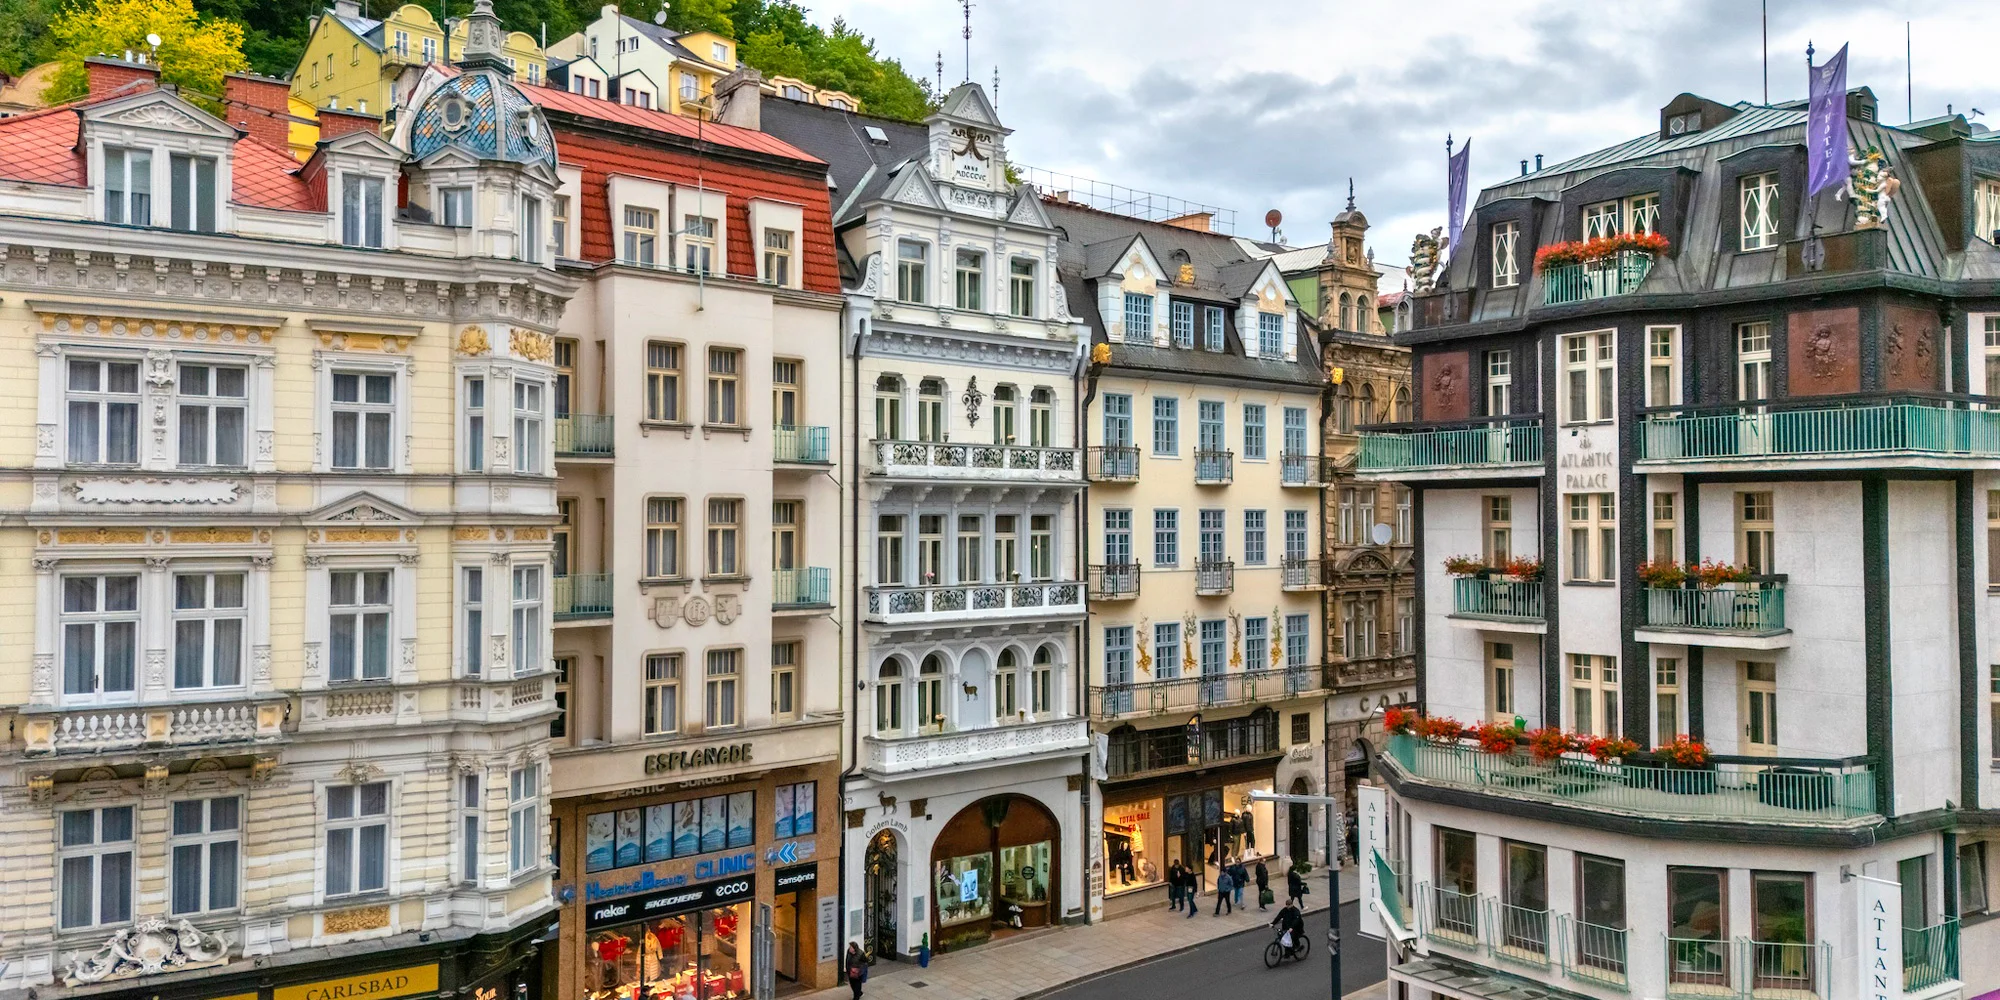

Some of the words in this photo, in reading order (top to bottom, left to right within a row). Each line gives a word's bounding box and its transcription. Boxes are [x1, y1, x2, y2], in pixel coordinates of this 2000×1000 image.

[1560, 452, 1613, 468] ATLANTIC
[1566, 473, 1608, 489] PALACE
[644, 743, 754, 775] ESPLANADE
[1119, 815, 1135, 824] TOTAL
[1136, 812, 1150, 822] SALE
[865, 820, 890, 839] Golden
[890, 819, 908, 833] Lamb
[694, 853, 756, 880] CLINIC
[1368, 802, 1377, 913] ATLANTIC
[715, 881, 749, 897] ecco
[644, 891, 703, 909] SKECHERS
[594, 904, 631, 920] rieker
[307, 975, 409, 1000] CARLSBAD
